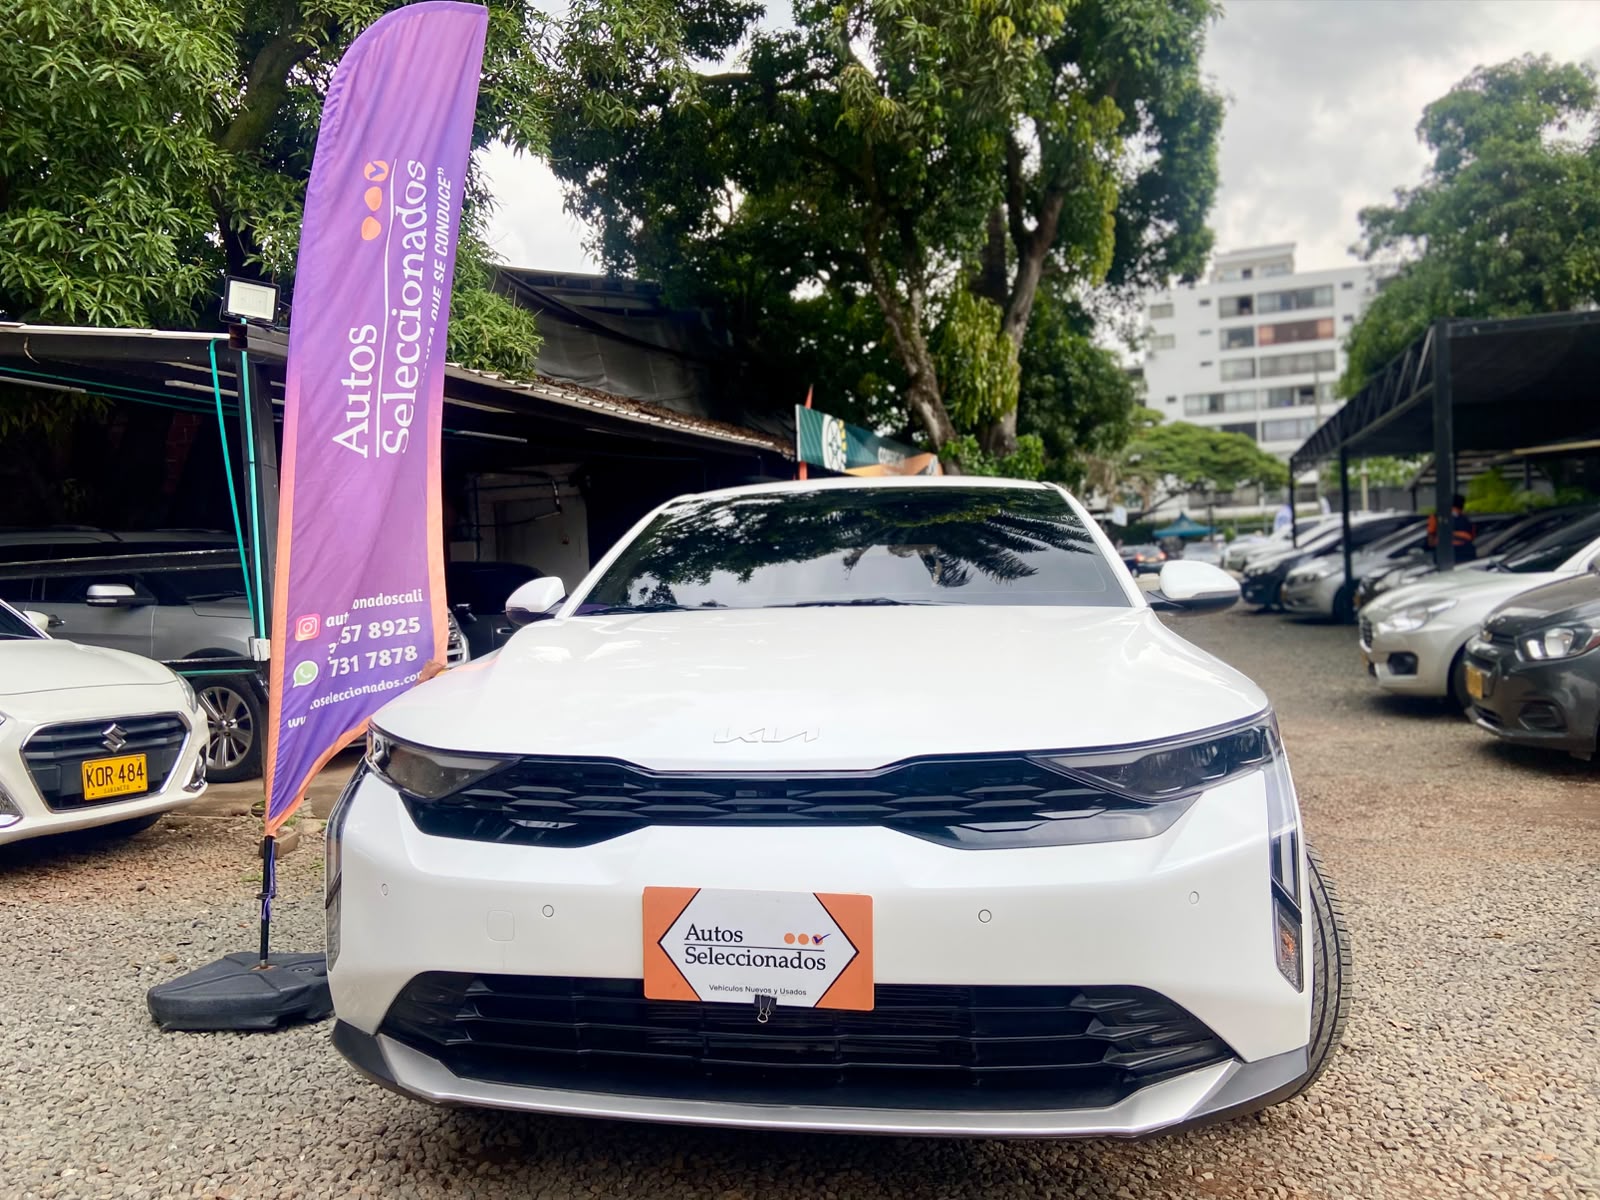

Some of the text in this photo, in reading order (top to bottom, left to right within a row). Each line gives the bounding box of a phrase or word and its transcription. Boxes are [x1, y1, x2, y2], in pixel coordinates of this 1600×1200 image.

[433, 259, 446, 283] SE
[382, 159, 428, 454] Seleccionados
[332, 324, 378, 458] Autos
[368, 616, 421, 639] 8925
[365, 645, 418, 670] 7878
[85, 761, 145, 789] KOR 484
[683, 923, 744, 943] Autos
[684, 946, 827, 971] Seleccionados
[744, 986, 772, 994] Nuevos
[779, 987, 807, 997] Usados
